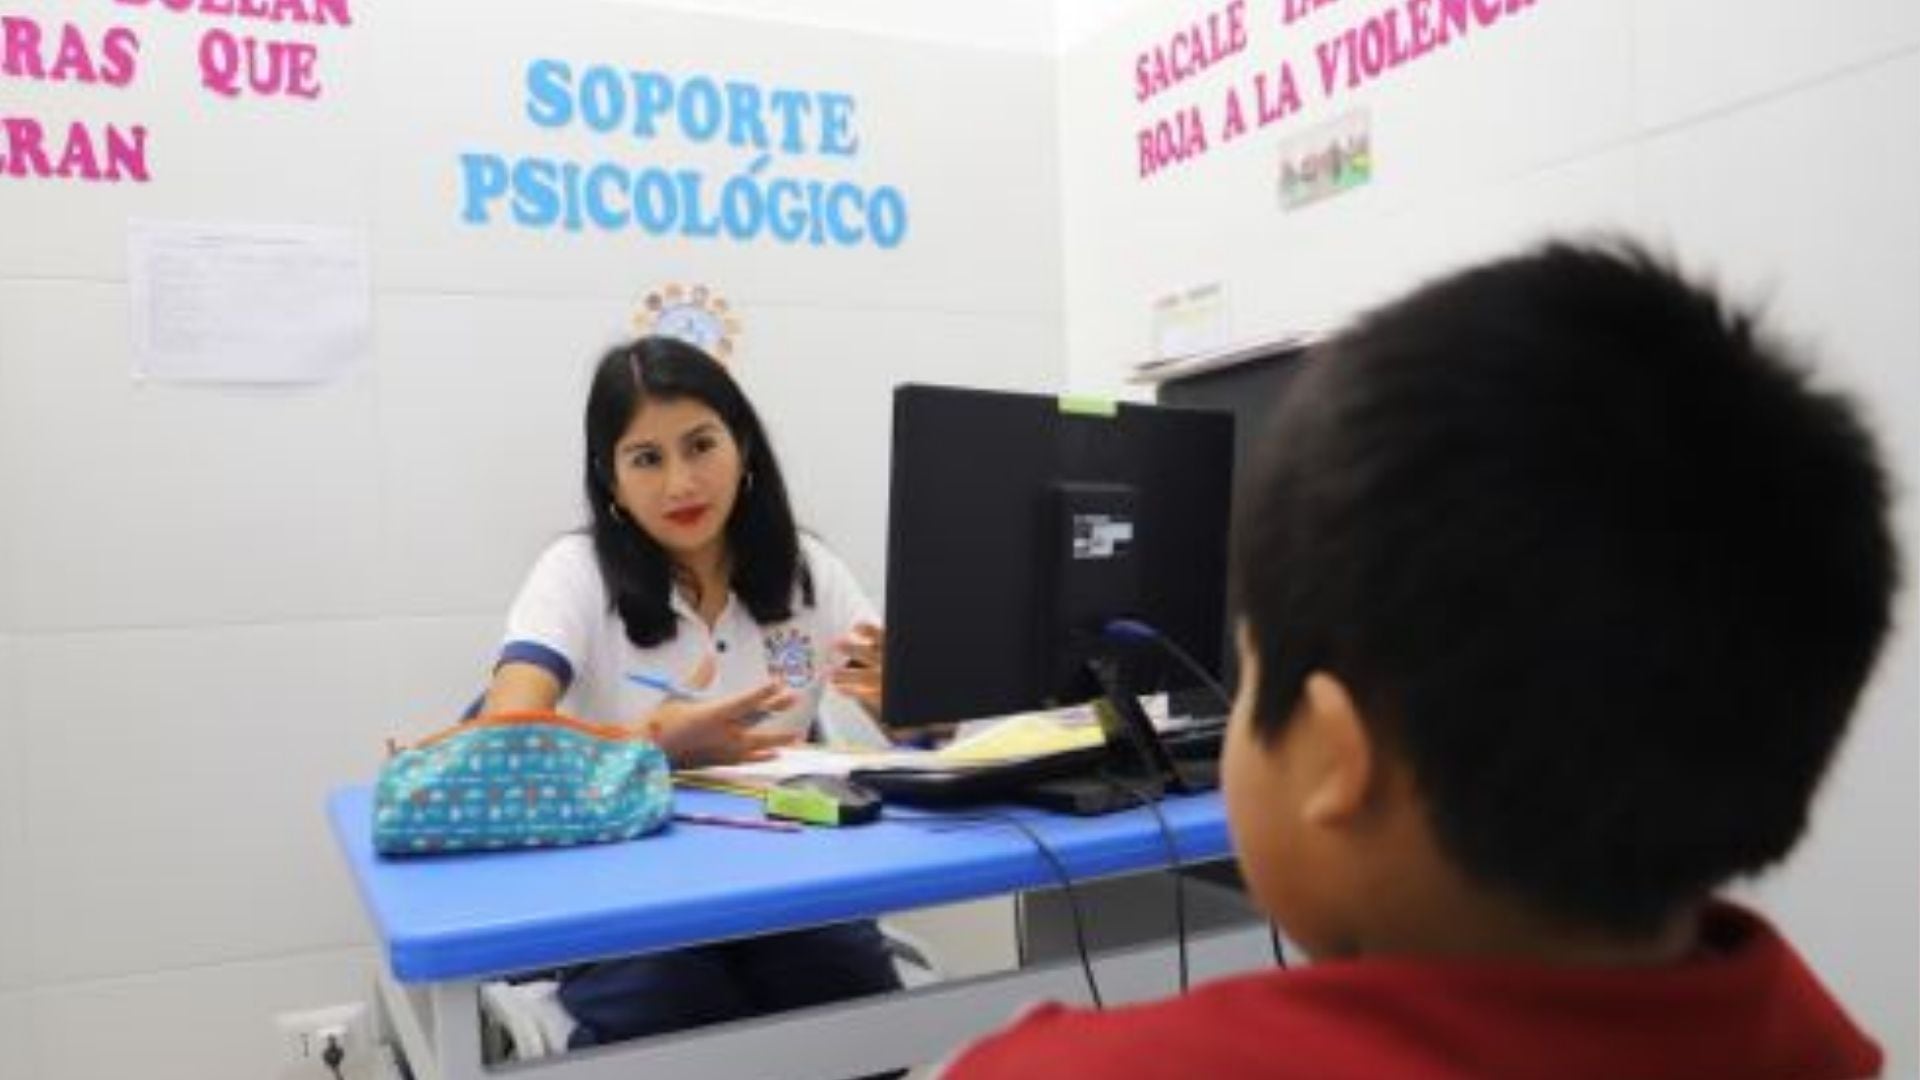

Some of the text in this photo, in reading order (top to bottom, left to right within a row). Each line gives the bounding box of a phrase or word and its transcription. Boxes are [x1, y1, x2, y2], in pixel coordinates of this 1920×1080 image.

[0, 16, 321, 98] RAS QUE
[1137, 0, 1247, 102] SACALE
[1139, 0, 1537, 177] ROJA A LA VIOLEN
[0, 117, 150, 182] RAN
[527, 58, 858, 157] SOPORTE
[460, 152, 908, 249] PSICOLÓGICO
